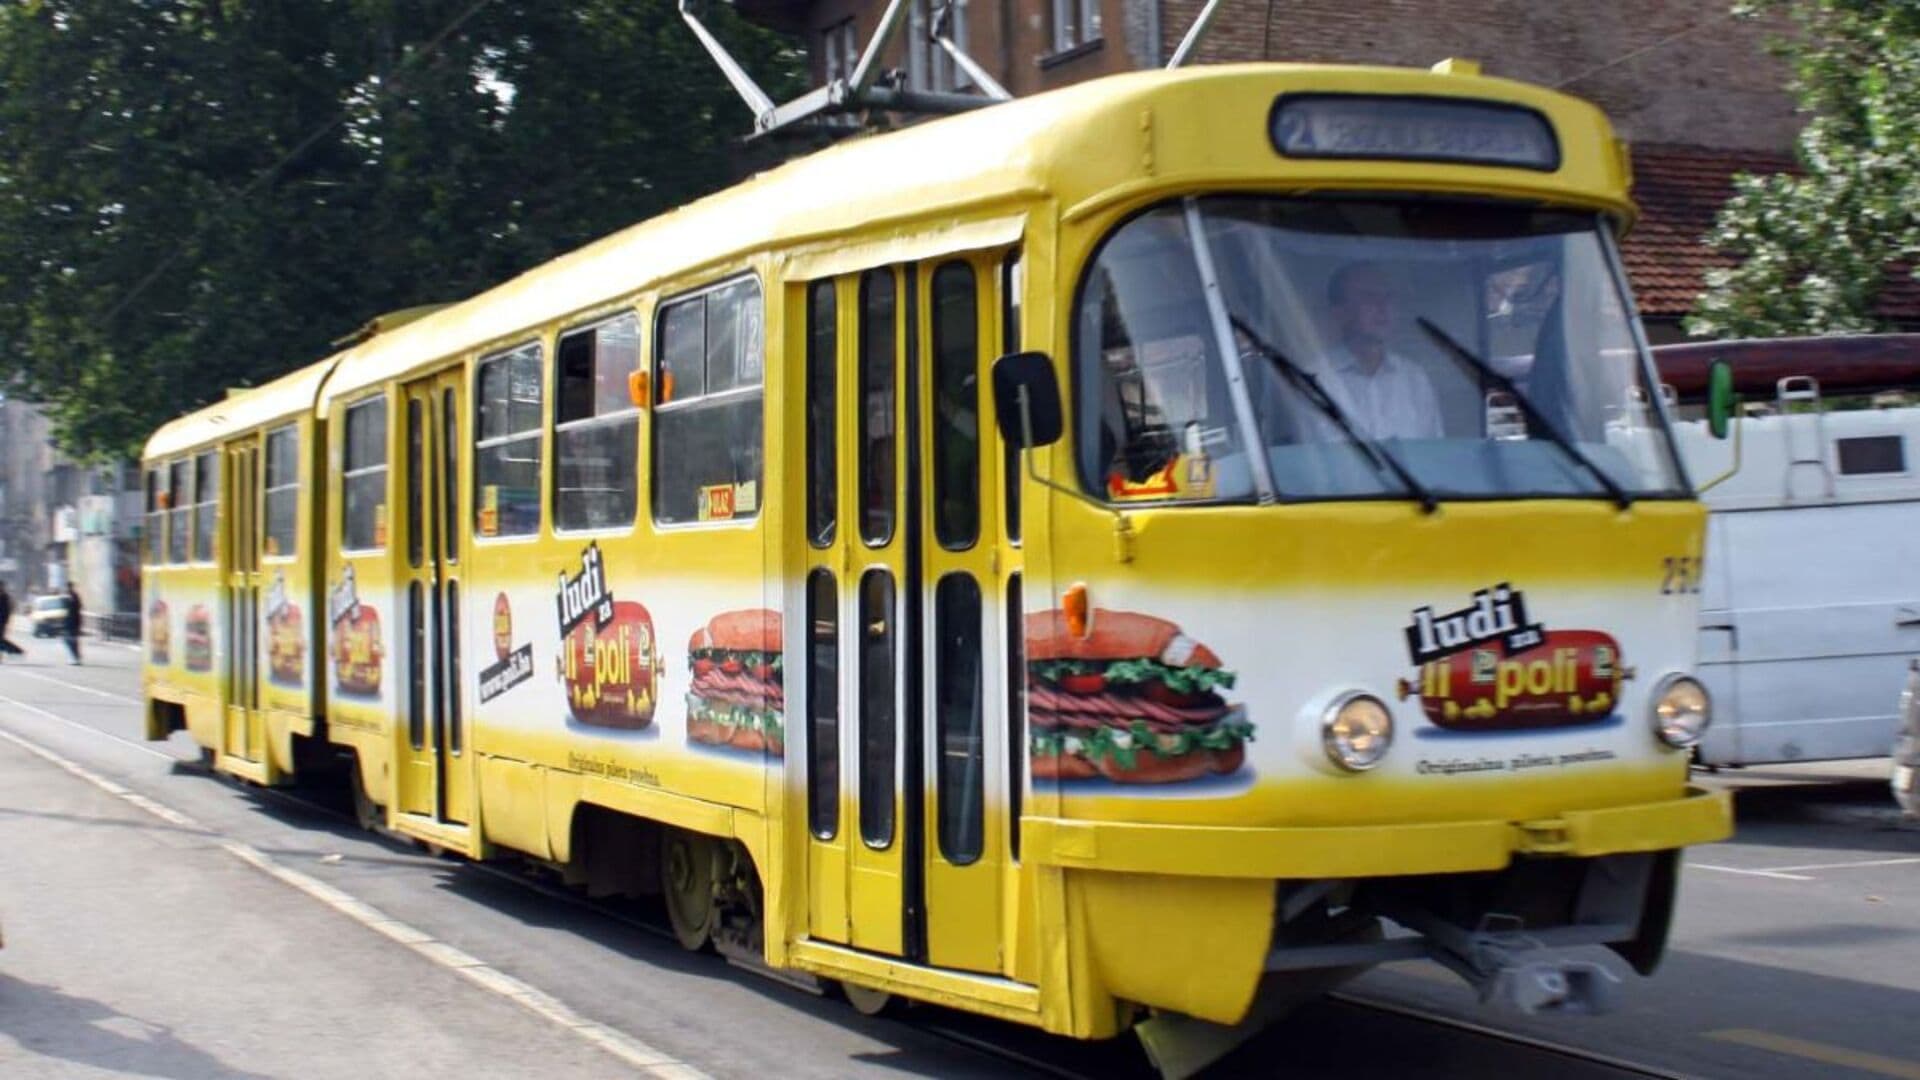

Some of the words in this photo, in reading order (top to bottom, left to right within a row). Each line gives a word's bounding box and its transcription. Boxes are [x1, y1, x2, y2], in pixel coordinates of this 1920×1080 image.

[559, 545, 603, 625] ludi
[1414, 588, 1516, 653] ludi
[595, 625, 631, 698] poli
[1496, 647, 1578, 710] poli
